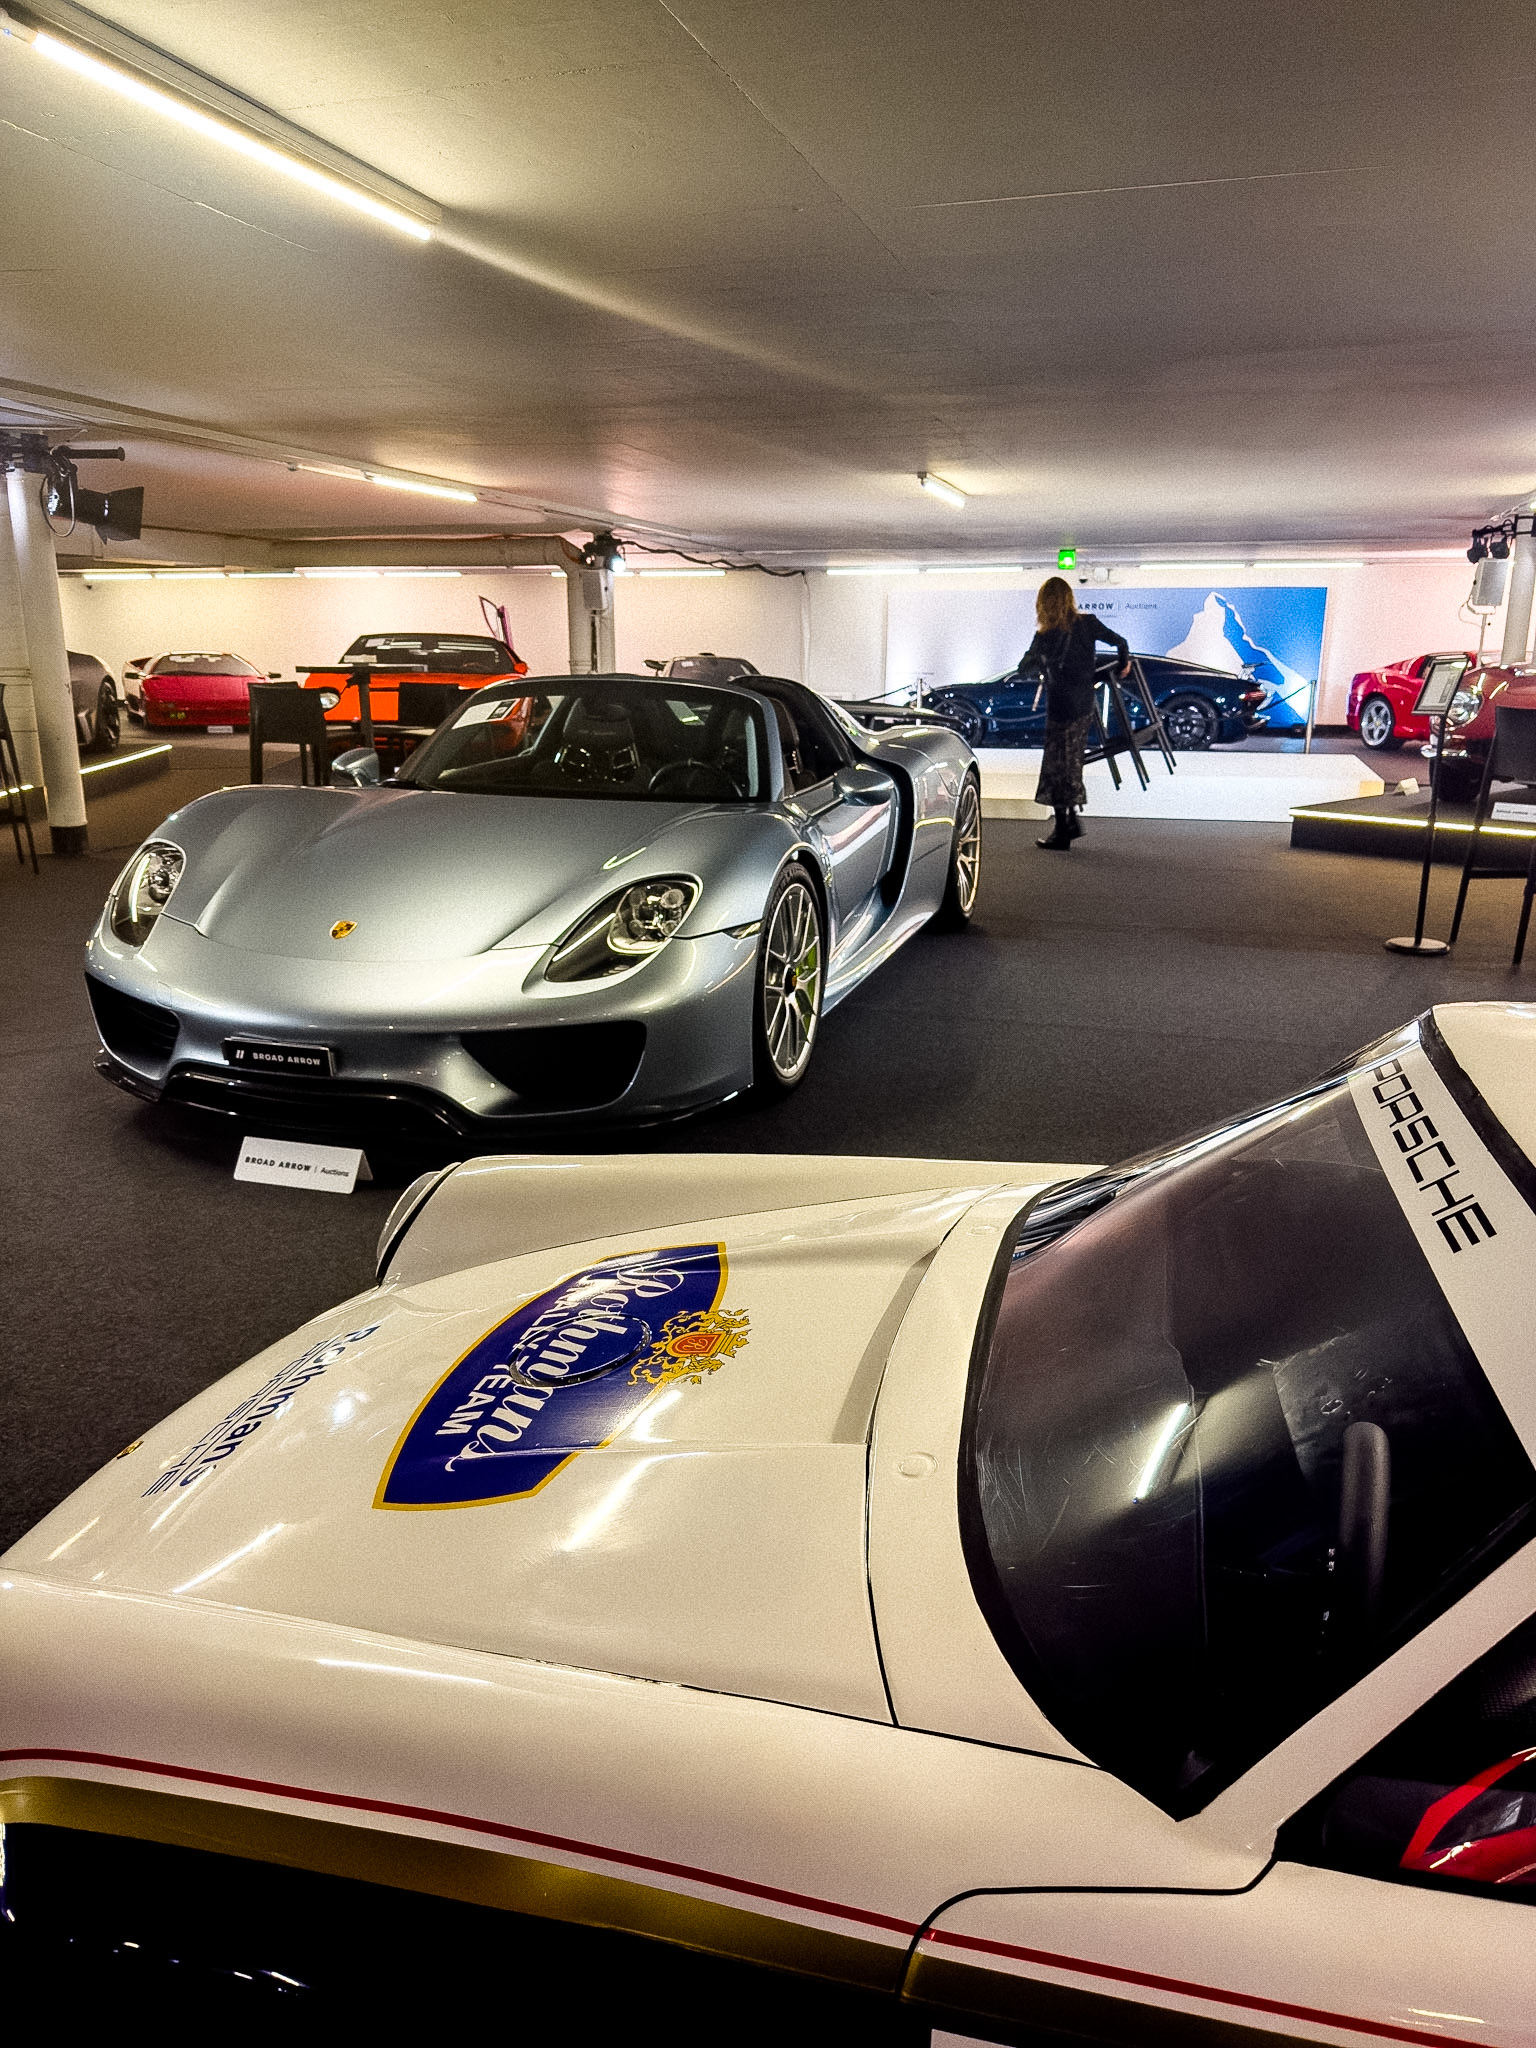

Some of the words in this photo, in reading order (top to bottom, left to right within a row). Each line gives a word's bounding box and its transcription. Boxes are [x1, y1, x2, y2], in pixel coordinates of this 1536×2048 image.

[1077, 602, 1114, 610] ARROW
[253, 1052, 284, 1063] BROAD
[287, 1056, 321, 1066] ARROW
[245, 1156, 276, 1167] BROAD
[278, 1161, 312, 1171] ARROW
[320, 1167, 350, 1178] Auctions
[1366, 1058, 1498, 1254] PORSCHE
[435, 1356, 530, 1437] TEAM
[445, 1266, 684, 1472] Rothmans
[141, 1338, 331, 1498] PORSCHE
